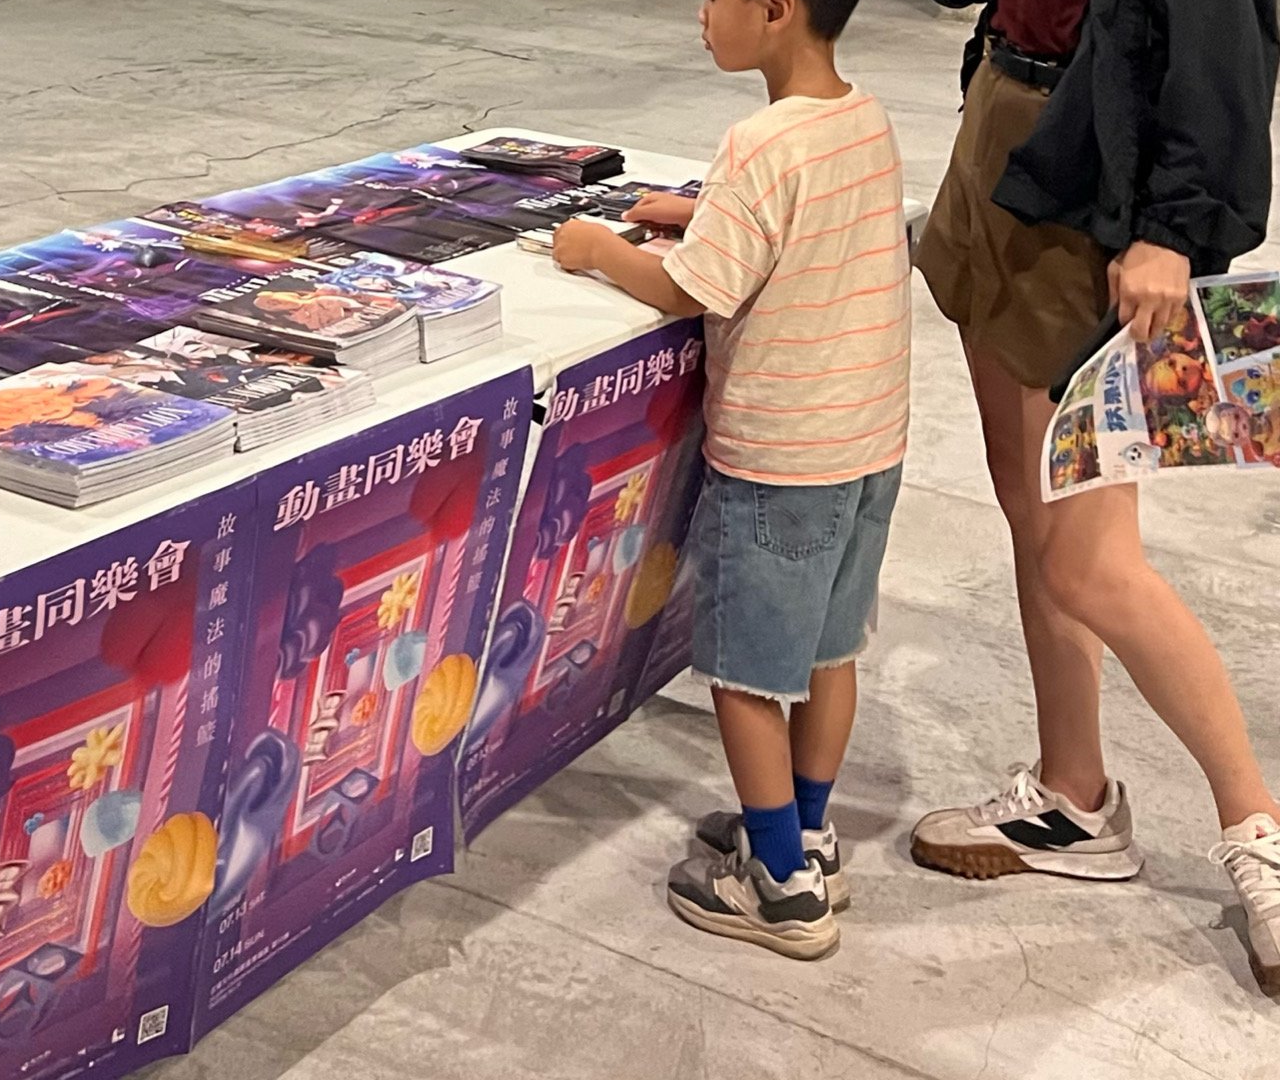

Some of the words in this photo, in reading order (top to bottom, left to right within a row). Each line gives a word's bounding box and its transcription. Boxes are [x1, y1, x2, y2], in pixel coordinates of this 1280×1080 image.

[273, 416, 484, 532] 動畫同樂會
